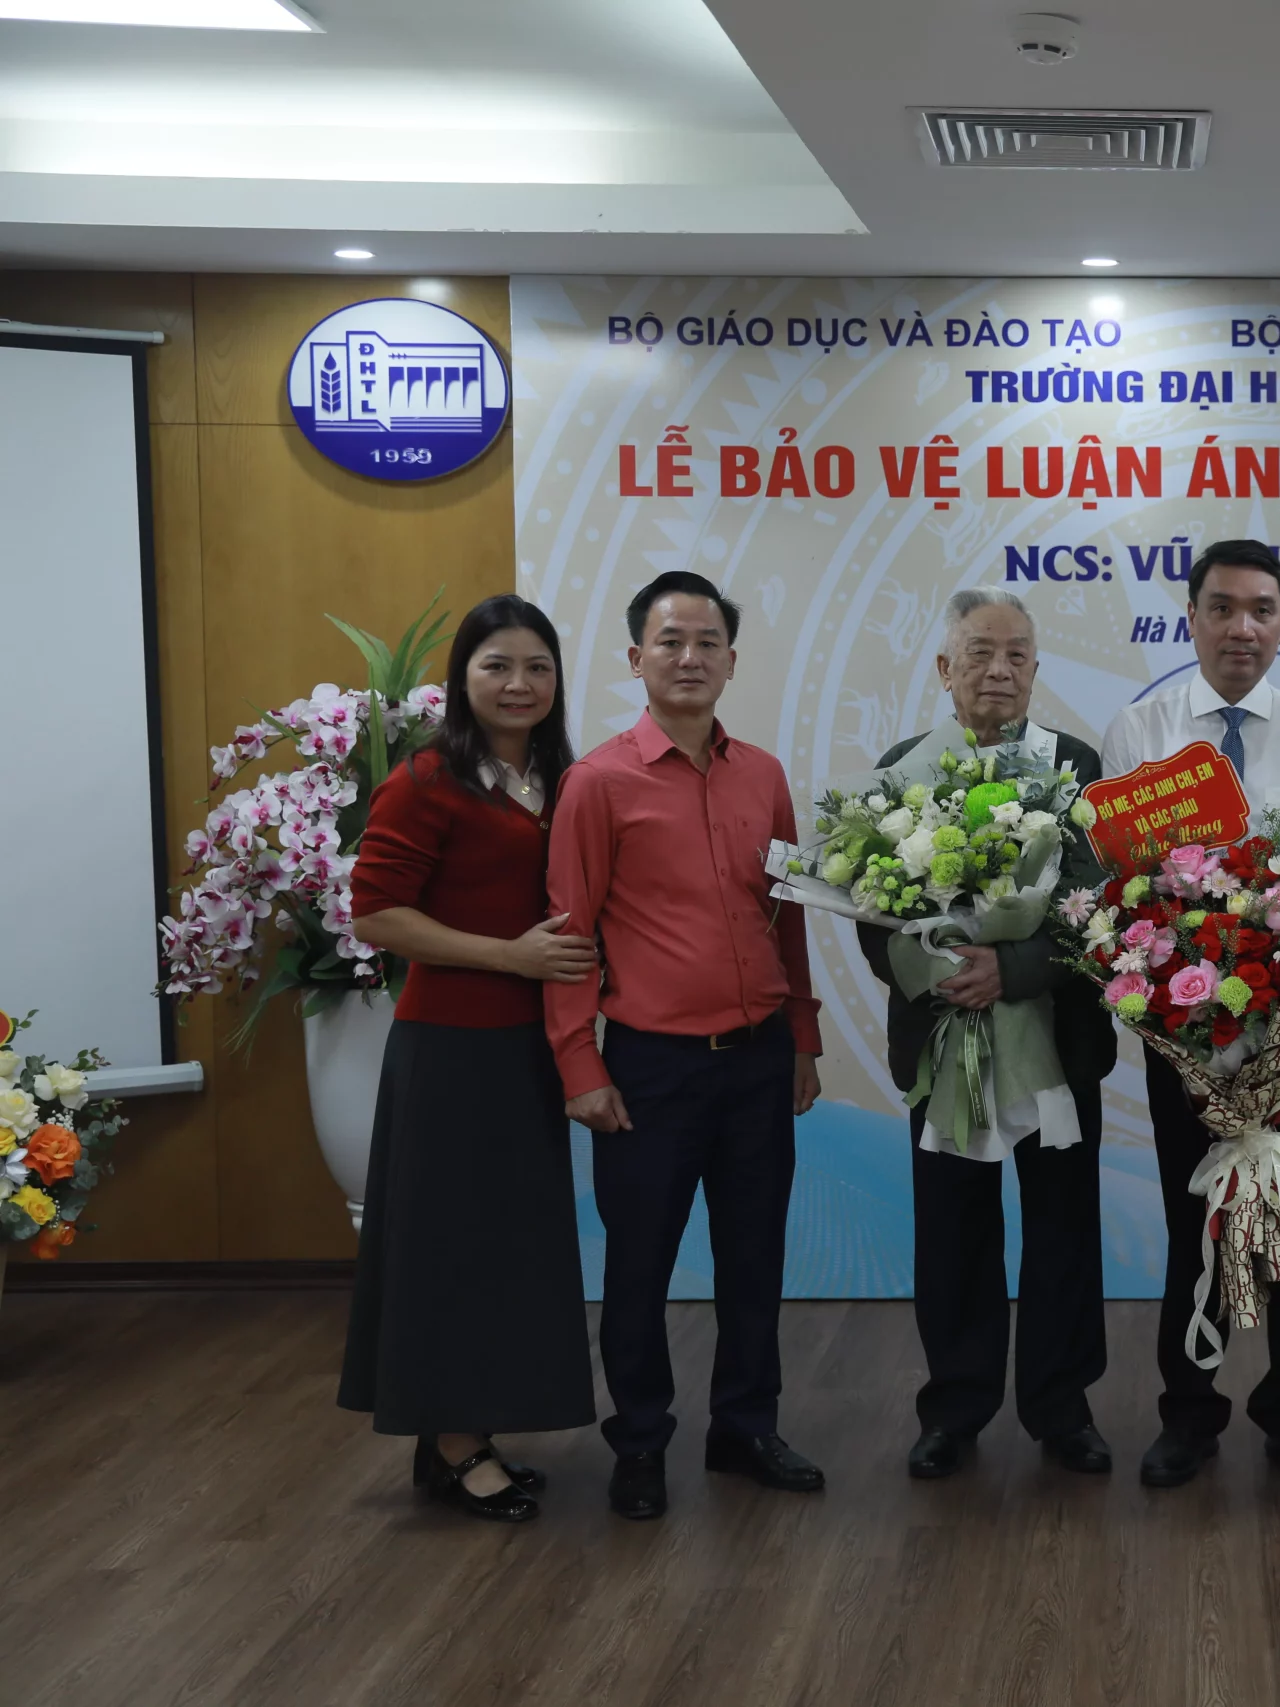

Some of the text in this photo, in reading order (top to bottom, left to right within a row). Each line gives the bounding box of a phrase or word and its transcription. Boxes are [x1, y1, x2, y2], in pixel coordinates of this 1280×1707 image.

[608, 309, 1122, 354] BỘ GIÁO DỤC VÀ ĐÀO TẠO
[965, 362, 1144, 404] TRƯỜNG
[1159, 370, 1234, 411] ĐẠI
[370, 447, 433, 465] 1959
[619, 424, 693, 498] LỄ
[720, 427, 855, 499] BẢO
[880, 434, 960, 511] VỆ
[986, 434, 1162, 511] LUẬN
[1187, 434, 1280, 499] ÁN
[1004, 544, 1113, 582] NCS:
[1127, 535, 1193, 582] VŨ
[1130, 615, 1167, 643] Hà
[1097, 761, 1215, 821] BỐ MẸ, CÁC ANH CHỊ, EM
[1134, 797, 1199, 835] VÀ CÁC CHÁU
